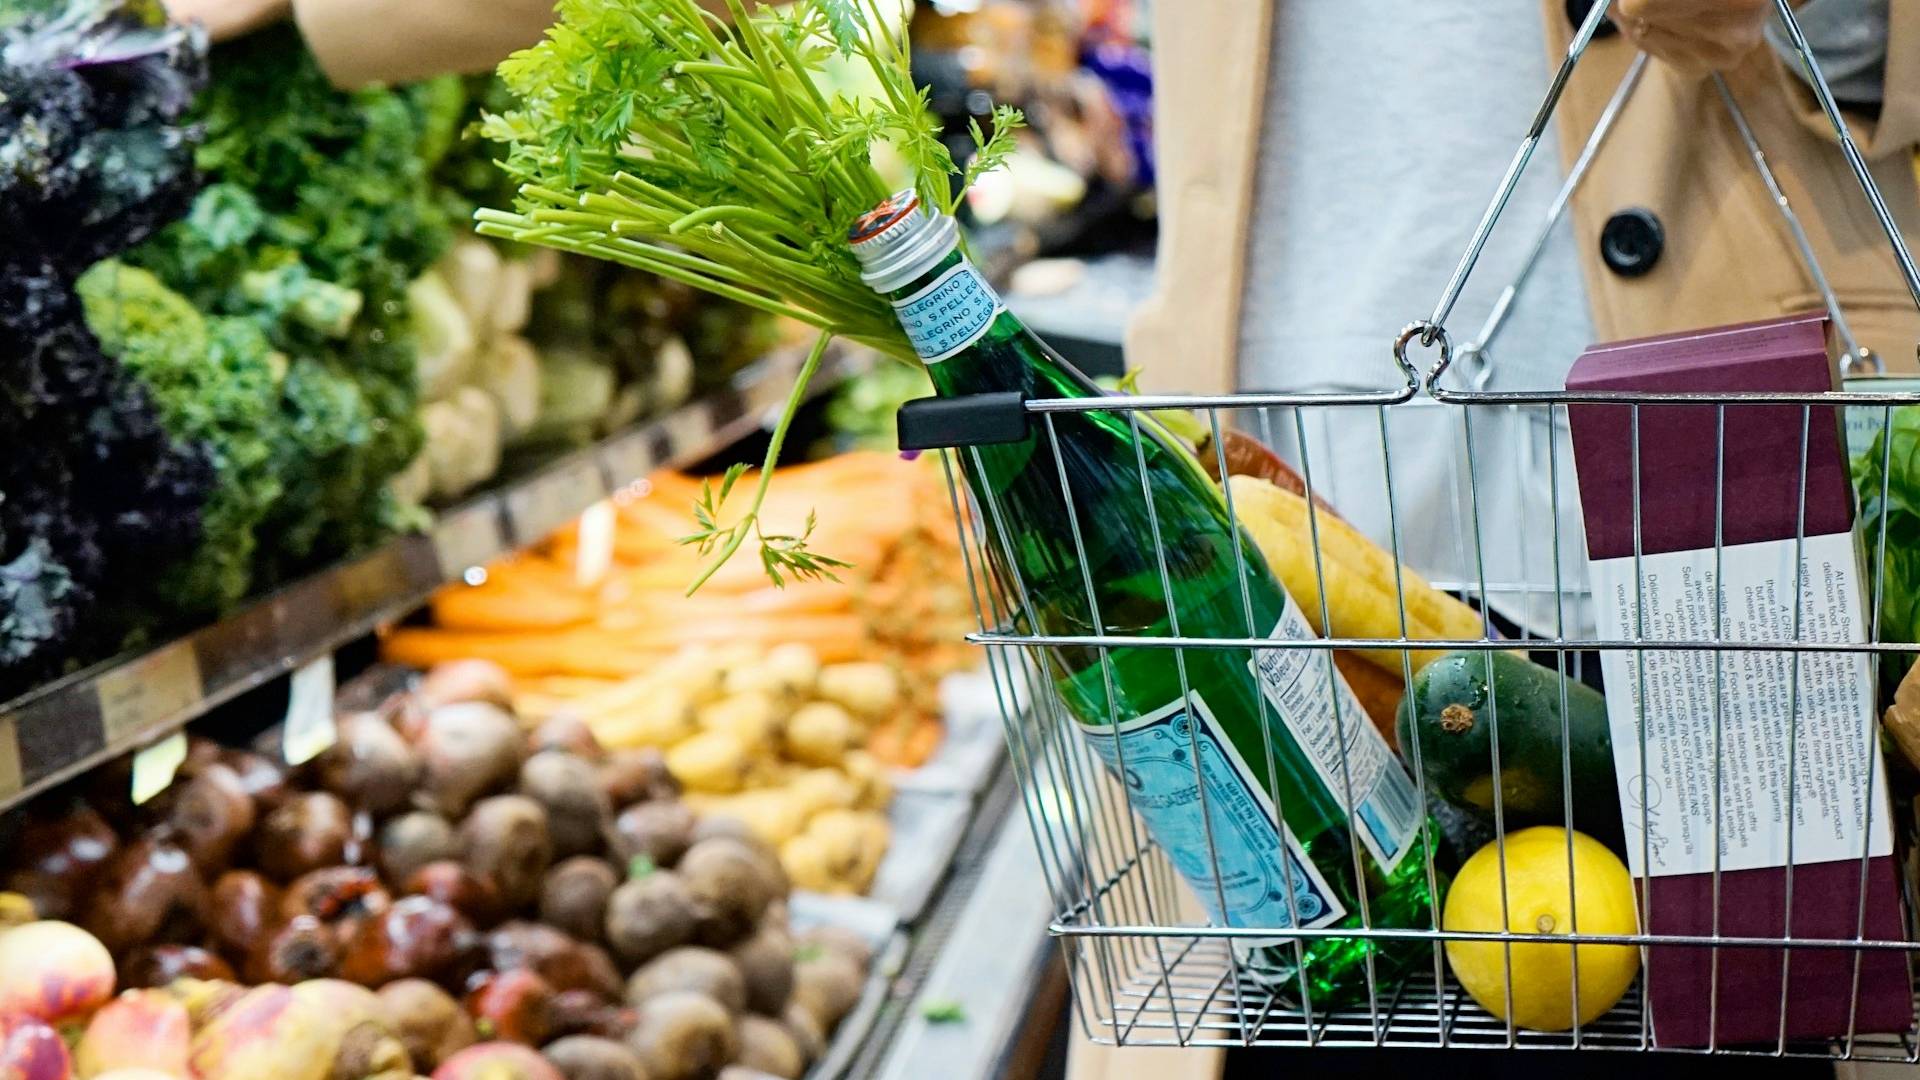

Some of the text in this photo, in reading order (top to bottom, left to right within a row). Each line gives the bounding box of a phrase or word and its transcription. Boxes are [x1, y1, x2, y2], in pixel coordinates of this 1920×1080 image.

[1682, 565, 1693, 587] Seul
[1705, 570, 1714, 582] de
[1823, 561, 1836, 602] delicious
[1835, 570, 1844, 579] At
[1617, 583, 1626, 606] vous
[1647, 573, 1661, 616] Délicieux
[1685, 590, 1692, 601] un
[1755, 585, 1765, 600] but
[1765, 579, 1777, 604] these
[1835, 583, 1848, 613] Lesley
[1620, 608, 1628, 620] ne
[1744, 585, 1757, 621] cheese
[1806, 600, 1815, 615] her
[1654, 619, 1661, 630] au
[1685, 604, 1699, 637] produit
[1755, 603, 1768, 628] really
[1767, 608, 1781, 639] unique
[1818, 613, 1826, 628] are
[1722, 616, 1733, 641] Stow
[1749, 623, 1756, 632] or
[1781, 614, 1793, 643] CRIS
[1808, 618, 1819, 643] team
[1841, 616, 1852, 643] Stow
[1625, 659, 1638, 680] plus
[1649, 659, 1658, 671] de
[1681, 650, 1695, 684] pouvait
[1765, 658, 1776, 683] when
[1802, 658, 1814, 692] scratch
[1824, 660, 1834, 678] with
[1661, 670, 1669, 686] ces
[1671, 665, 1683, 696] POUR
[1729, 671, 1741, 700] Foods
[1757, 681, 1767, 696] We
[1815, 670, 1824, 685] the
[1836, 662, 1848, 701] fabulous
[1848, 672, 1860, 701] Foods
[1630, 682, 1639, 704] vous
[1649, 673, 1665, 719] trempette,
[1694, 674, 1709, 712] fabriqué
[1694, 580, 1703, 602] avec
[1701, 629, 1709, 641] en
[1723, 794, 1733, 807] de
[1746, 683, 1754, 698] are
[1766, 685, 1780, 717] topped
[1779, 683, 1787, 698] are
[1815, 687, 1827, 706] only
[1827, 681, 1836, 702] care
[1661, 688, 1677, 736] craquelins
[1676, 698, 1686, 720] CES
[1688, 686, 1701, 727] satisfaire
[1721, 691, 1734, 730] fabuleux
[1733, 702, 1745, 729] adore
[1749, 701, 1757, 721] sure
[1759, 699, 1767, 715] are
[1804, 694, 1818, 719] using
[1830, 705, 1839, 713] in
[1839, 703, 1852, 732] crisps
[1852, 703, 1860, 717] we
[1657, 721, 1667, 734] de
[1702, 715, 1710, 737] avec
[1773, 720, 1783, 738] with
[1810, 722, 1818, 737] our
[1818, 710, 1828, 728] way
[1831, 716, 1842, 740] small
[1854, 720, 1864, 739] love
[1679, 722, 1690, 746] FINS
[1750, 723, 1760, 741] you
[1761, 716, 1774, 756] addicted
[1822, 730, 1831, 739] to
[1657, 736, 1672, 775] fromage
[1670, 738, 1681, 759] sont
[1692, 730, 1705, 759] Lesley
[1705, 738, 1715, 756] des
[1735, 732, 1750, 773] fabriquer
[1754, 743, 1764, 758] will
[1774, 740, 1784, 760] your
[1813, 739, 1824, 764] finest
[1824, 742, 1835, 767] make
[1845, 734, 1855, 755] from
[1698, 761, 1707, 772] et
[1725, 732, 1741, 781] craquelins
[1757, 760, 1766, 772] be
[1767, 759, 1776, 768] to
[1855, 741, 1869, 776] making
[1664, 776, 1672, 788] ou
[1673, 761, 1688, 812] irrésistibles
[1682, 749, 1699, 816] CRAQUELINS
[1699, 774, 1708, 791] son
[1743, 775, 1752, 784] et
[1768, 770, 1778, 787] this
[1846, 757, 1861, 795] Lesley's
[1733, 782, 1744, 802] sont
[1744, 787, 1753, 808] vous
[1827, 779, 1839, 803] great
[1769, 789, 1781, 824] yummy
[1796, 806, 1804, 826] own
[1853, 797, 1865, 830] kitchen
[1734, 805, 1750, 848] fabriqués
[1748, 810, 1758, 832] offrir
[1830, 804, 1844, 840] product
